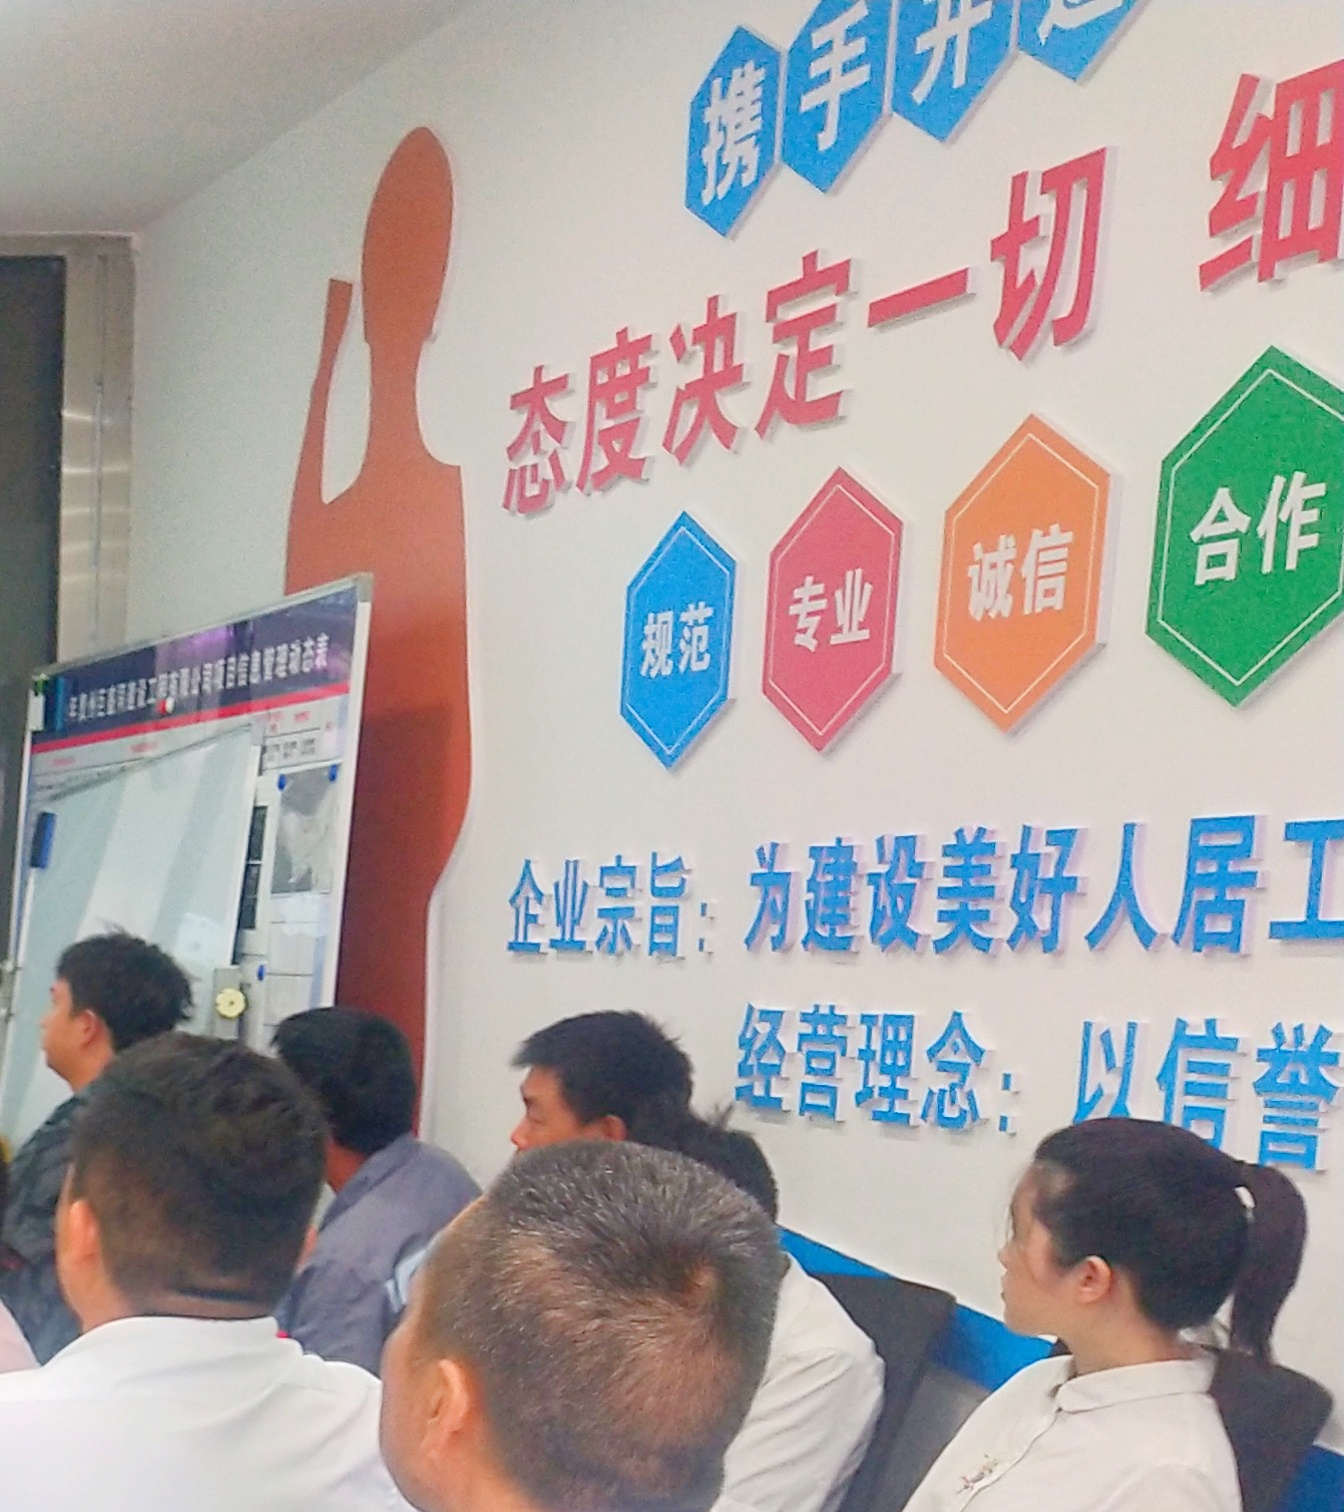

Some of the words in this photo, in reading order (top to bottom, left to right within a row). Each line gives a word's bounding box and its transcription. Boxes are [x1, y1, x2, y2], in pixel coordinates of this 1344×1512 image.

[503, 146, 1108, 512] 态度决定一切
[967, 523, 1075, 622] 诚信
[1188, 470, 1328, 588] 合作
[640, 602, 713, 680] 规范
[788, 570, 873, 653] 专业
